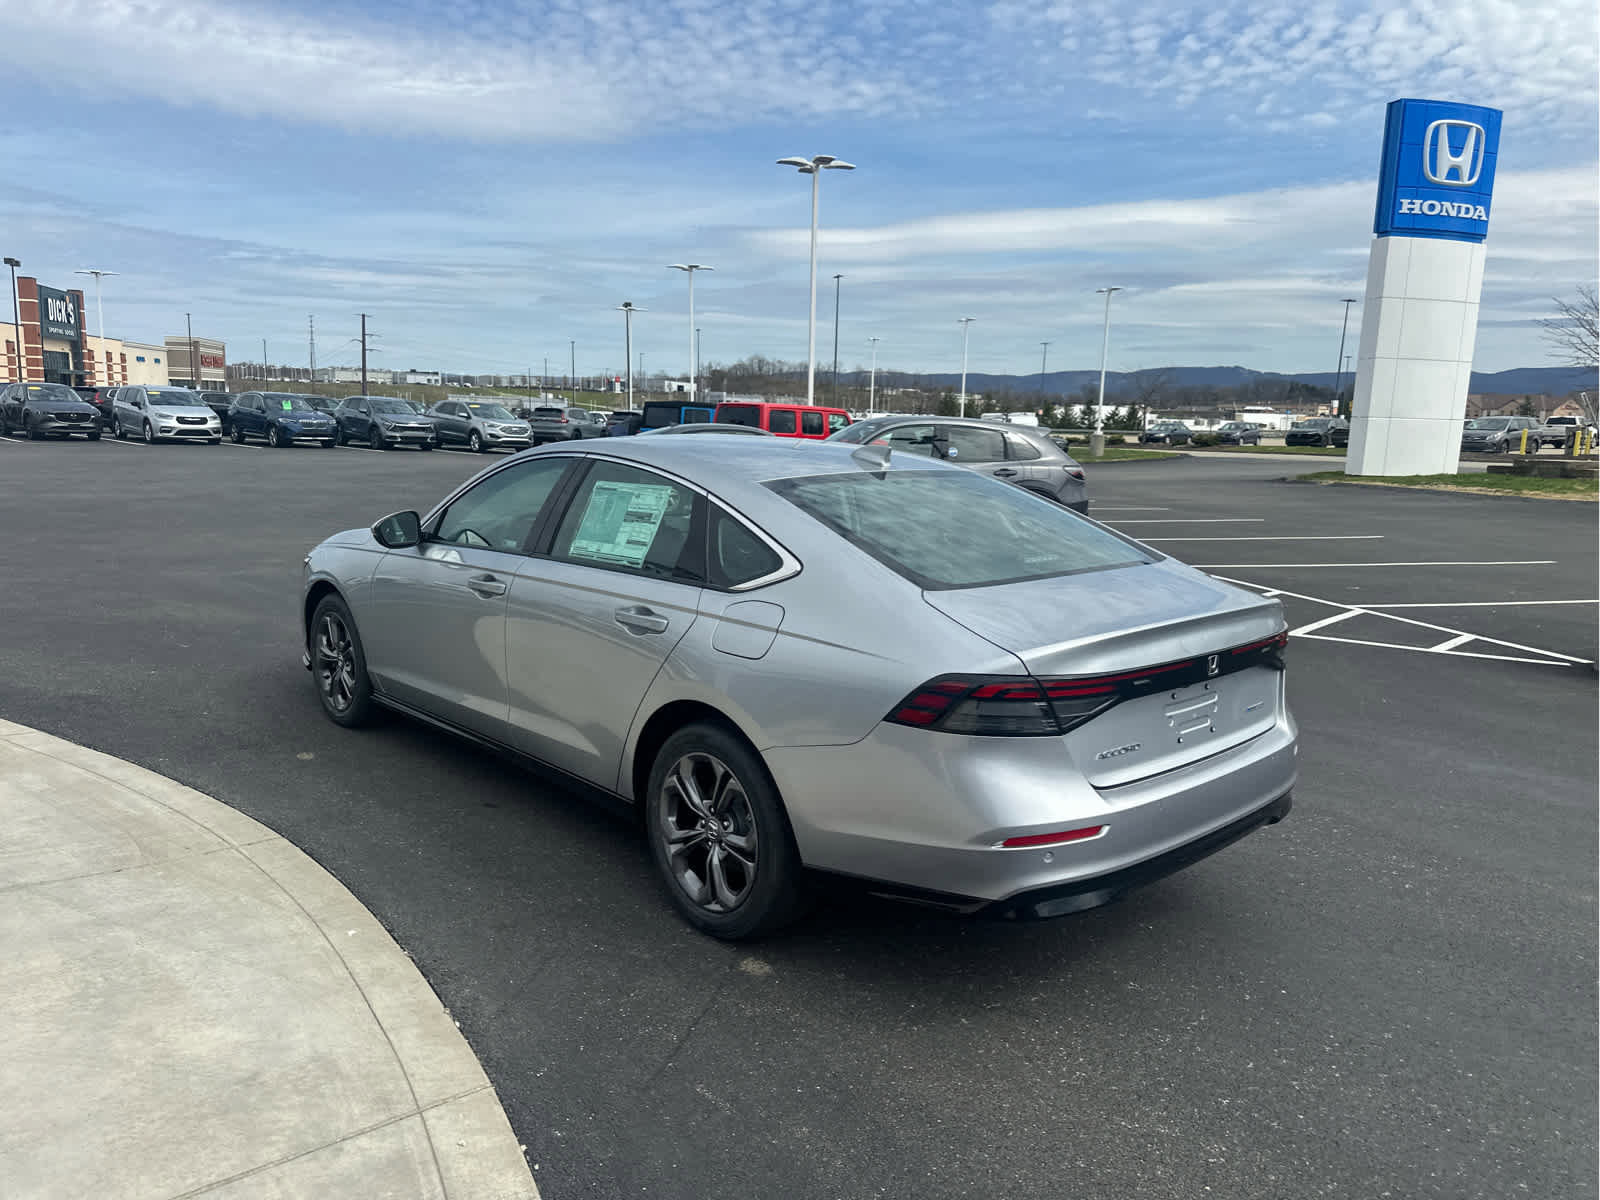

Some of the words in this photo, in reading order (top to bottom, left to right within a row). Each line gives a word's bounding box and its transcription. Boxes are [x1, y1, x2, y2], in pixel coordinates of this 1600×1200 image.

[1398, 199, 1488, 221] HONDA
[47, 296, 75, 325] DICK'S
[1096, 743, 1141, 760] ACCORD
